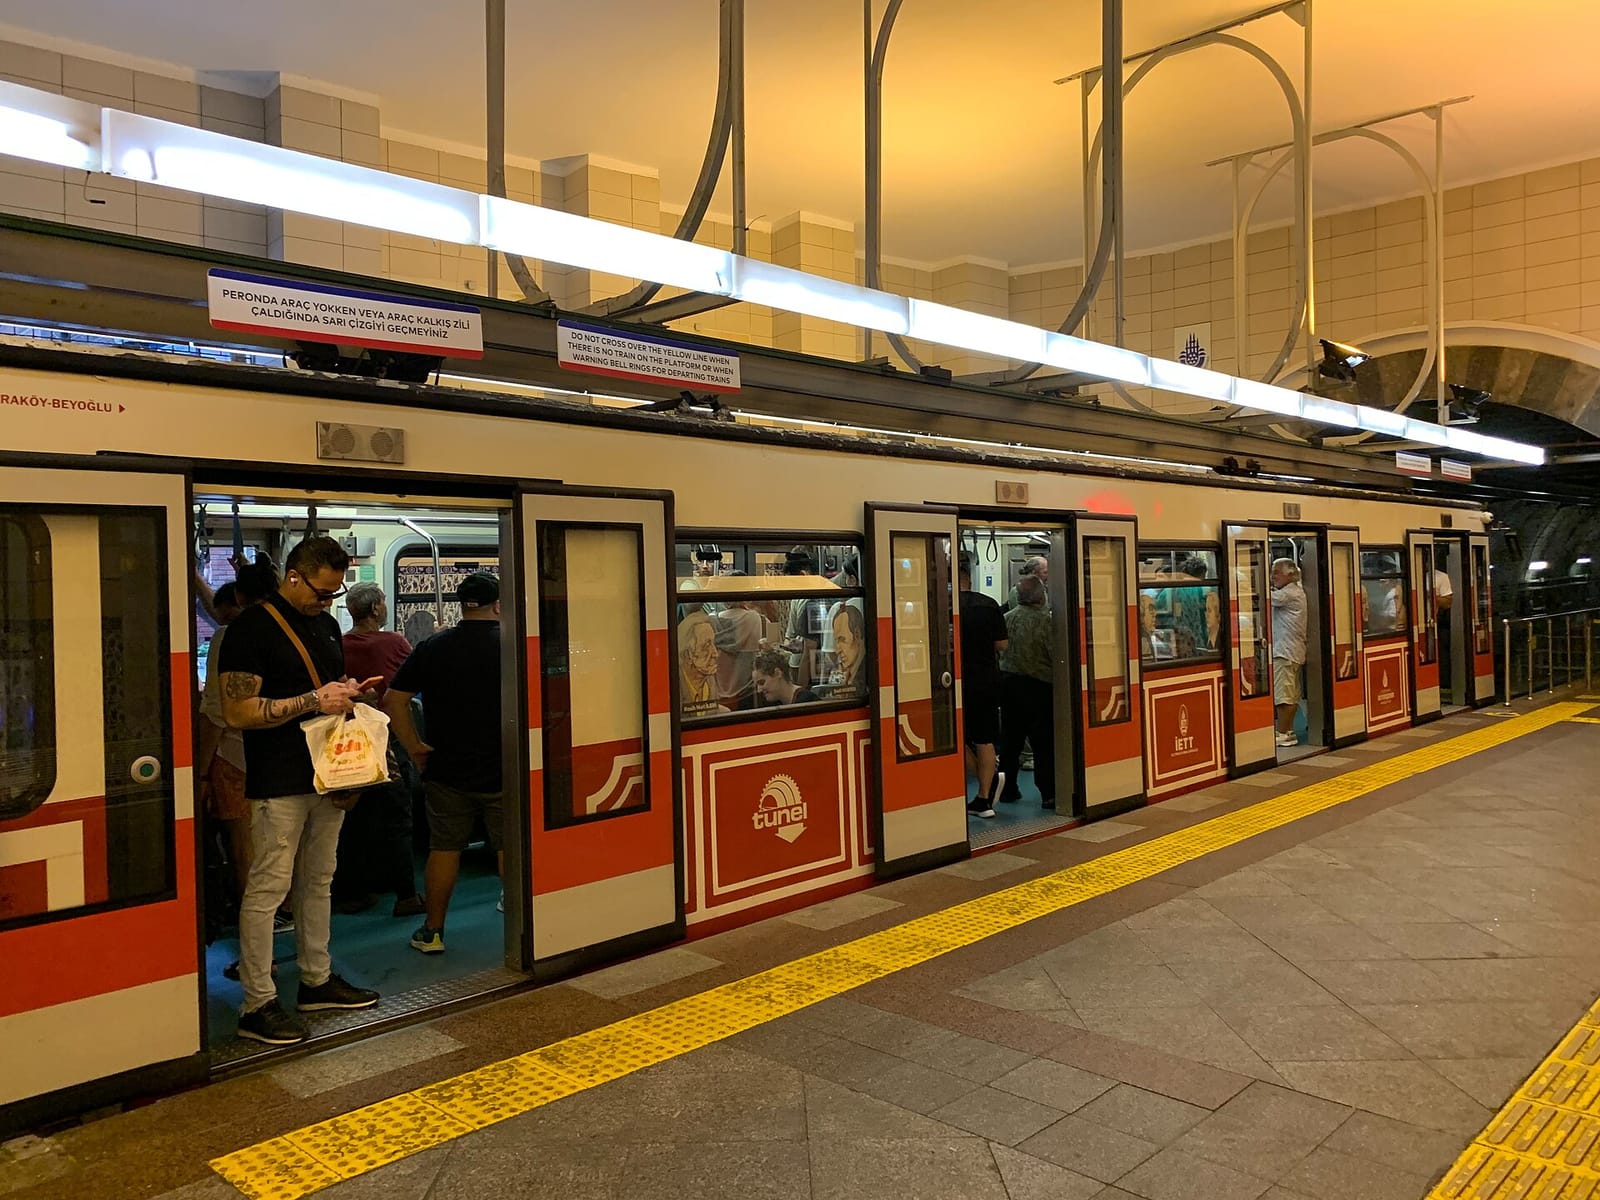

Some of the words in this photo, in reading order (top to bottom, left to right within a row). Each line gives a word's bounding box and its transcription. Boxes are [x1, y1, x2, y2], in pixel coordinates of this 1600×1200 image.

[222, 289, 278, 305] PERONDA
[281, 298, 310, 310] ARAÇ
[312, 302, 356, 316] YOKKEN
[358, 308, 385, 320] VEYA
[387, 312, 414, 324] ARAÇ
[416, 316, 451, 329] KALKIŞ
[453, 318, 470, 330] ZİLİ
[251, 306, 320, 323] ÇALDIĞINDA
[322, 316, 346, 327] SARI
[348, 318, 385, 332] ÇİZGİYİ
[387, 324, 448, 339] GEÇMEYİNİZ
[567, 341, 592, 353] THERE
[593, 346, 600, 354] IS
[601, 348, 613, 356] NO
[614, 350, 636, 360] TRAIN
[637, 354, 648, 362] ON
[649, 356, 663, 365] THE
[664, 358, 701, 370] PLATFORM
[702, 364, 712, 372] OR
[712, 366, 734, 375] WHEN
[571, 332, 583, 341] DO
[584, 334, 600, 343] NOT
[601, 338, 626, 348] CROSS
[627, 342, 647, 352] OVER
[648, 345, 662, 355] THE
[662, 348, 692, 360] YELLOW
[692, 354, 708, 362] LINE
[709, 356, 730, 365] WHEN
[572, 353, 609, 366] WARNING
[610, 360, 628, 369] BELL
[629, 362, 651, 373] RINGS
[652, 366, 667, 374] FOR
[668, 369, 706, 381] DEPARTING
[707, 374, 731, 384] TRAINS
[752, 802, 807, 830] tunel
